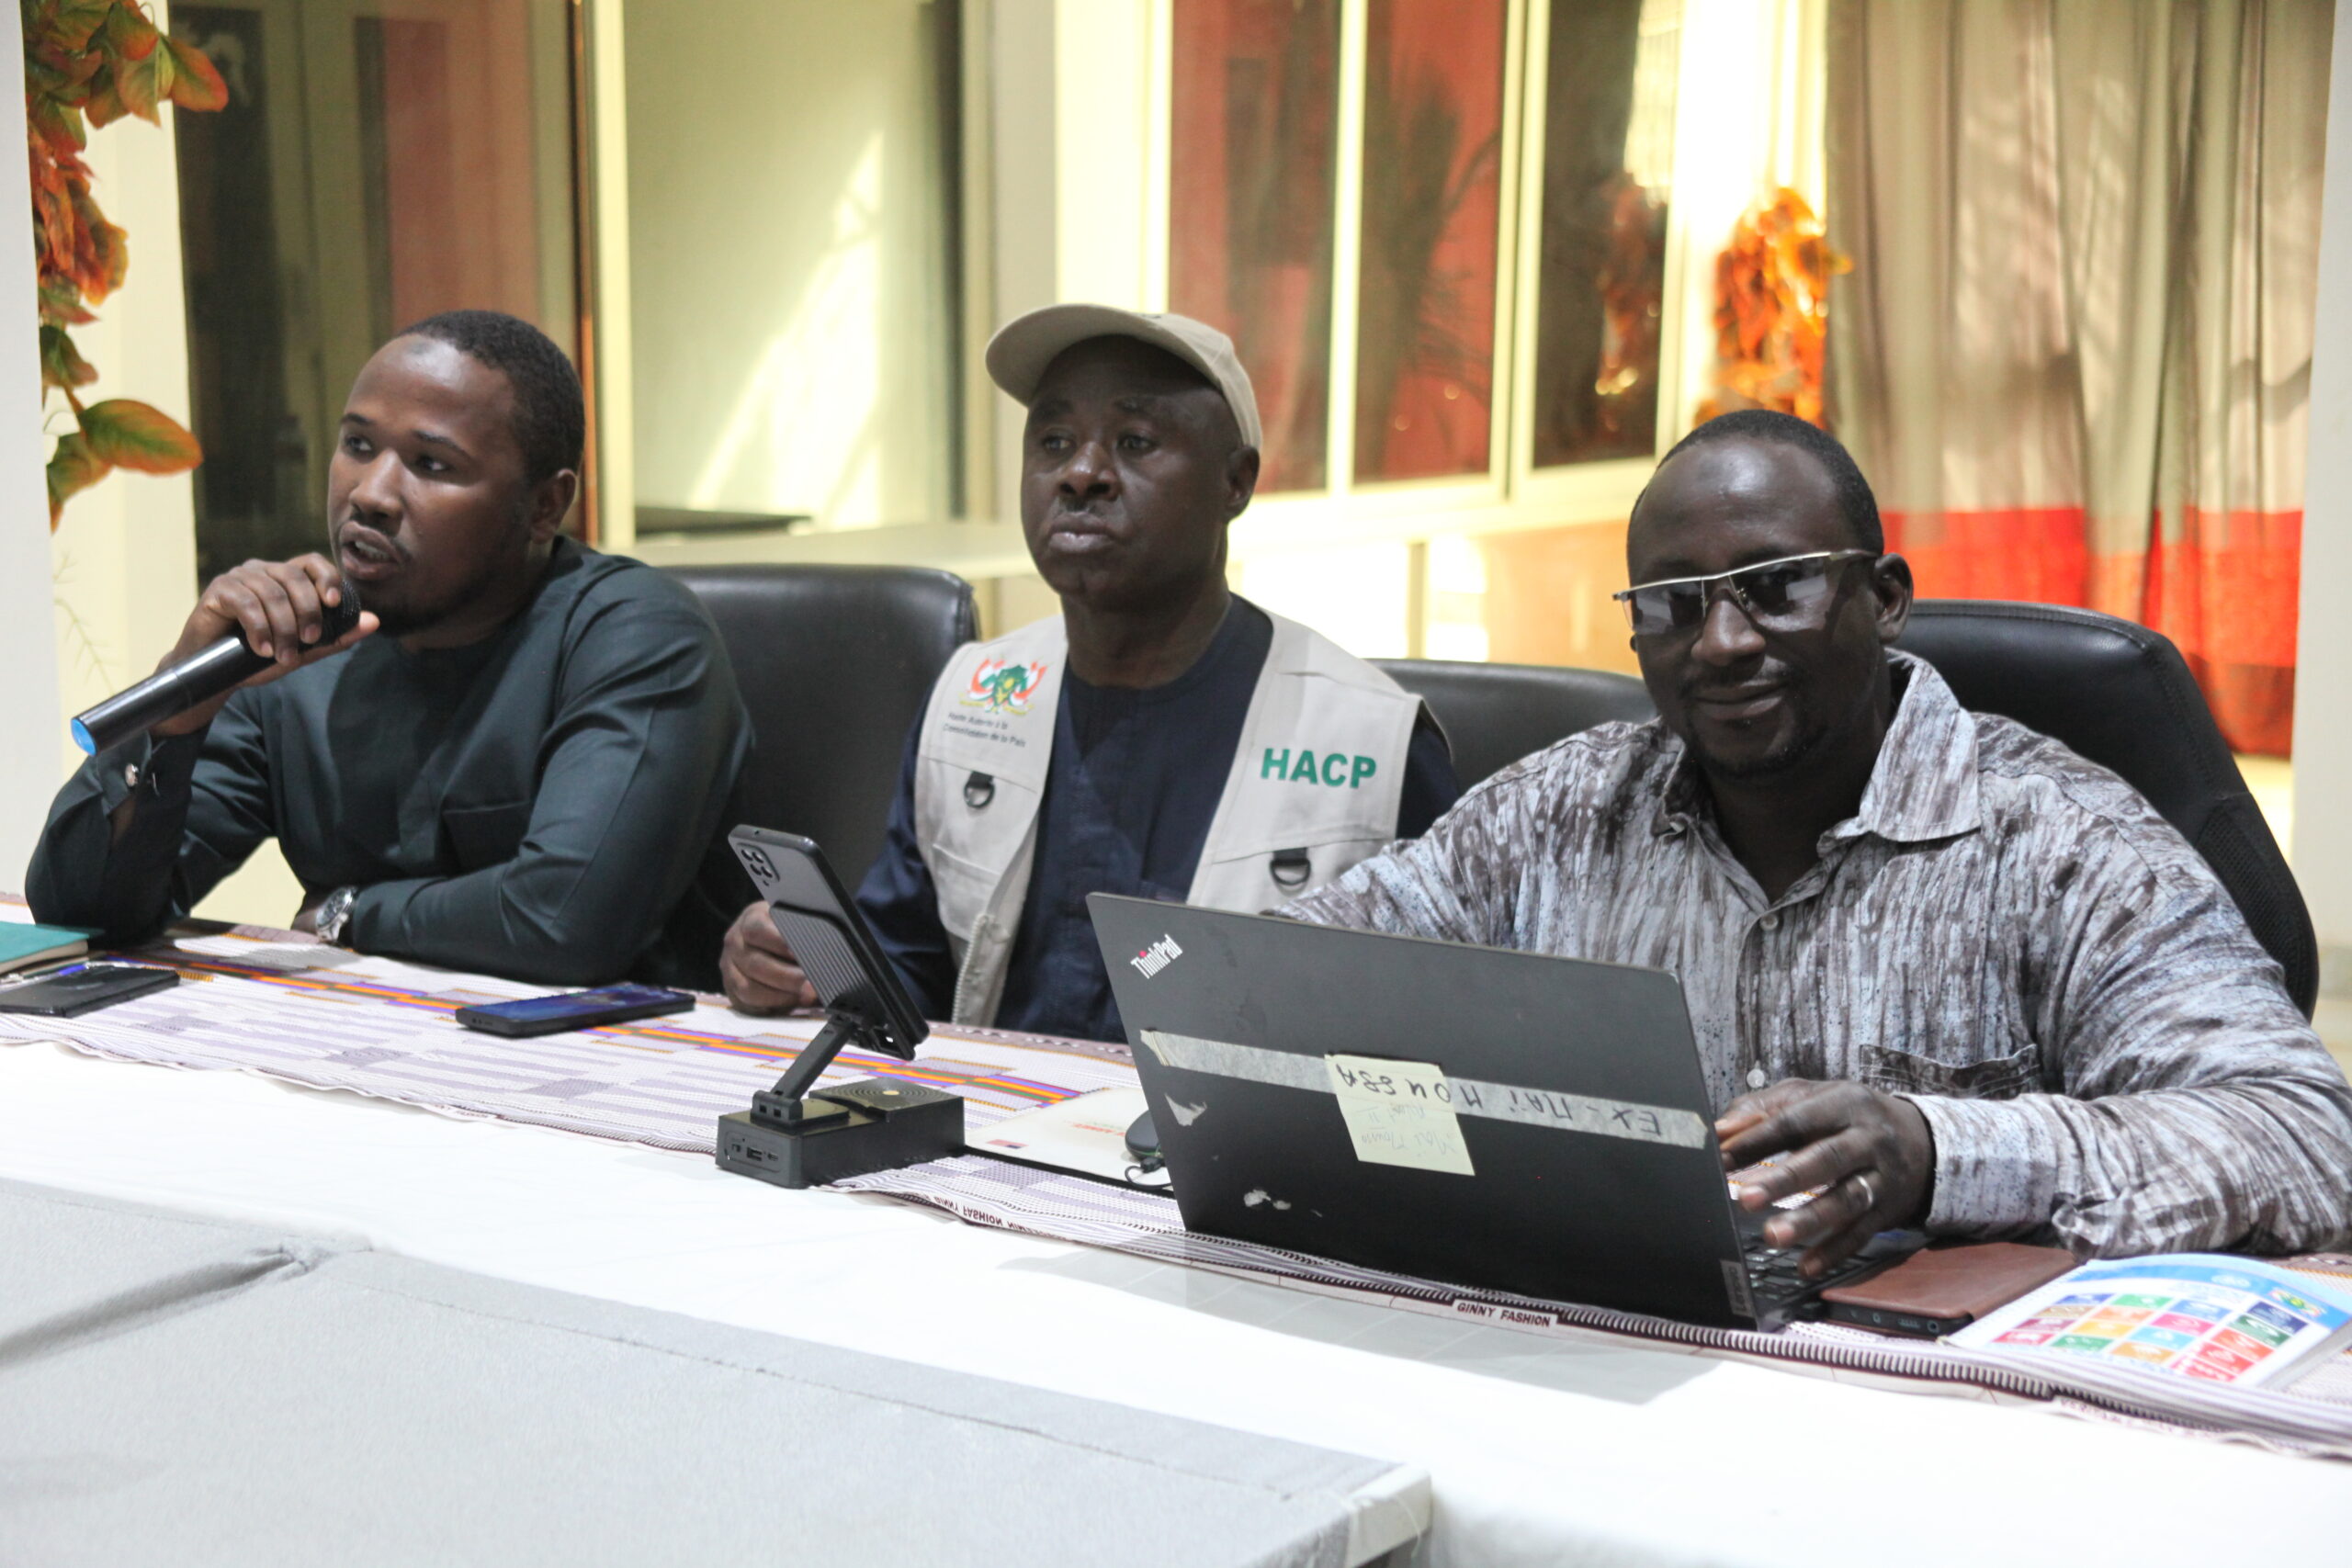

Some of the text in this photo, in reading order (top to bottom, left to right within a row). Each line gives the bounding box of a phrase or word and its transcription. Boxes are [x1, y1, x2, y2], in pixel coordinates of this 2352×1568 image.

[1261, 748, 1377, 789] HACP
[1130, 933, 1183, 979] ThinkPad
[1457, 1302, 1551, 1327] GINNY FASHION
